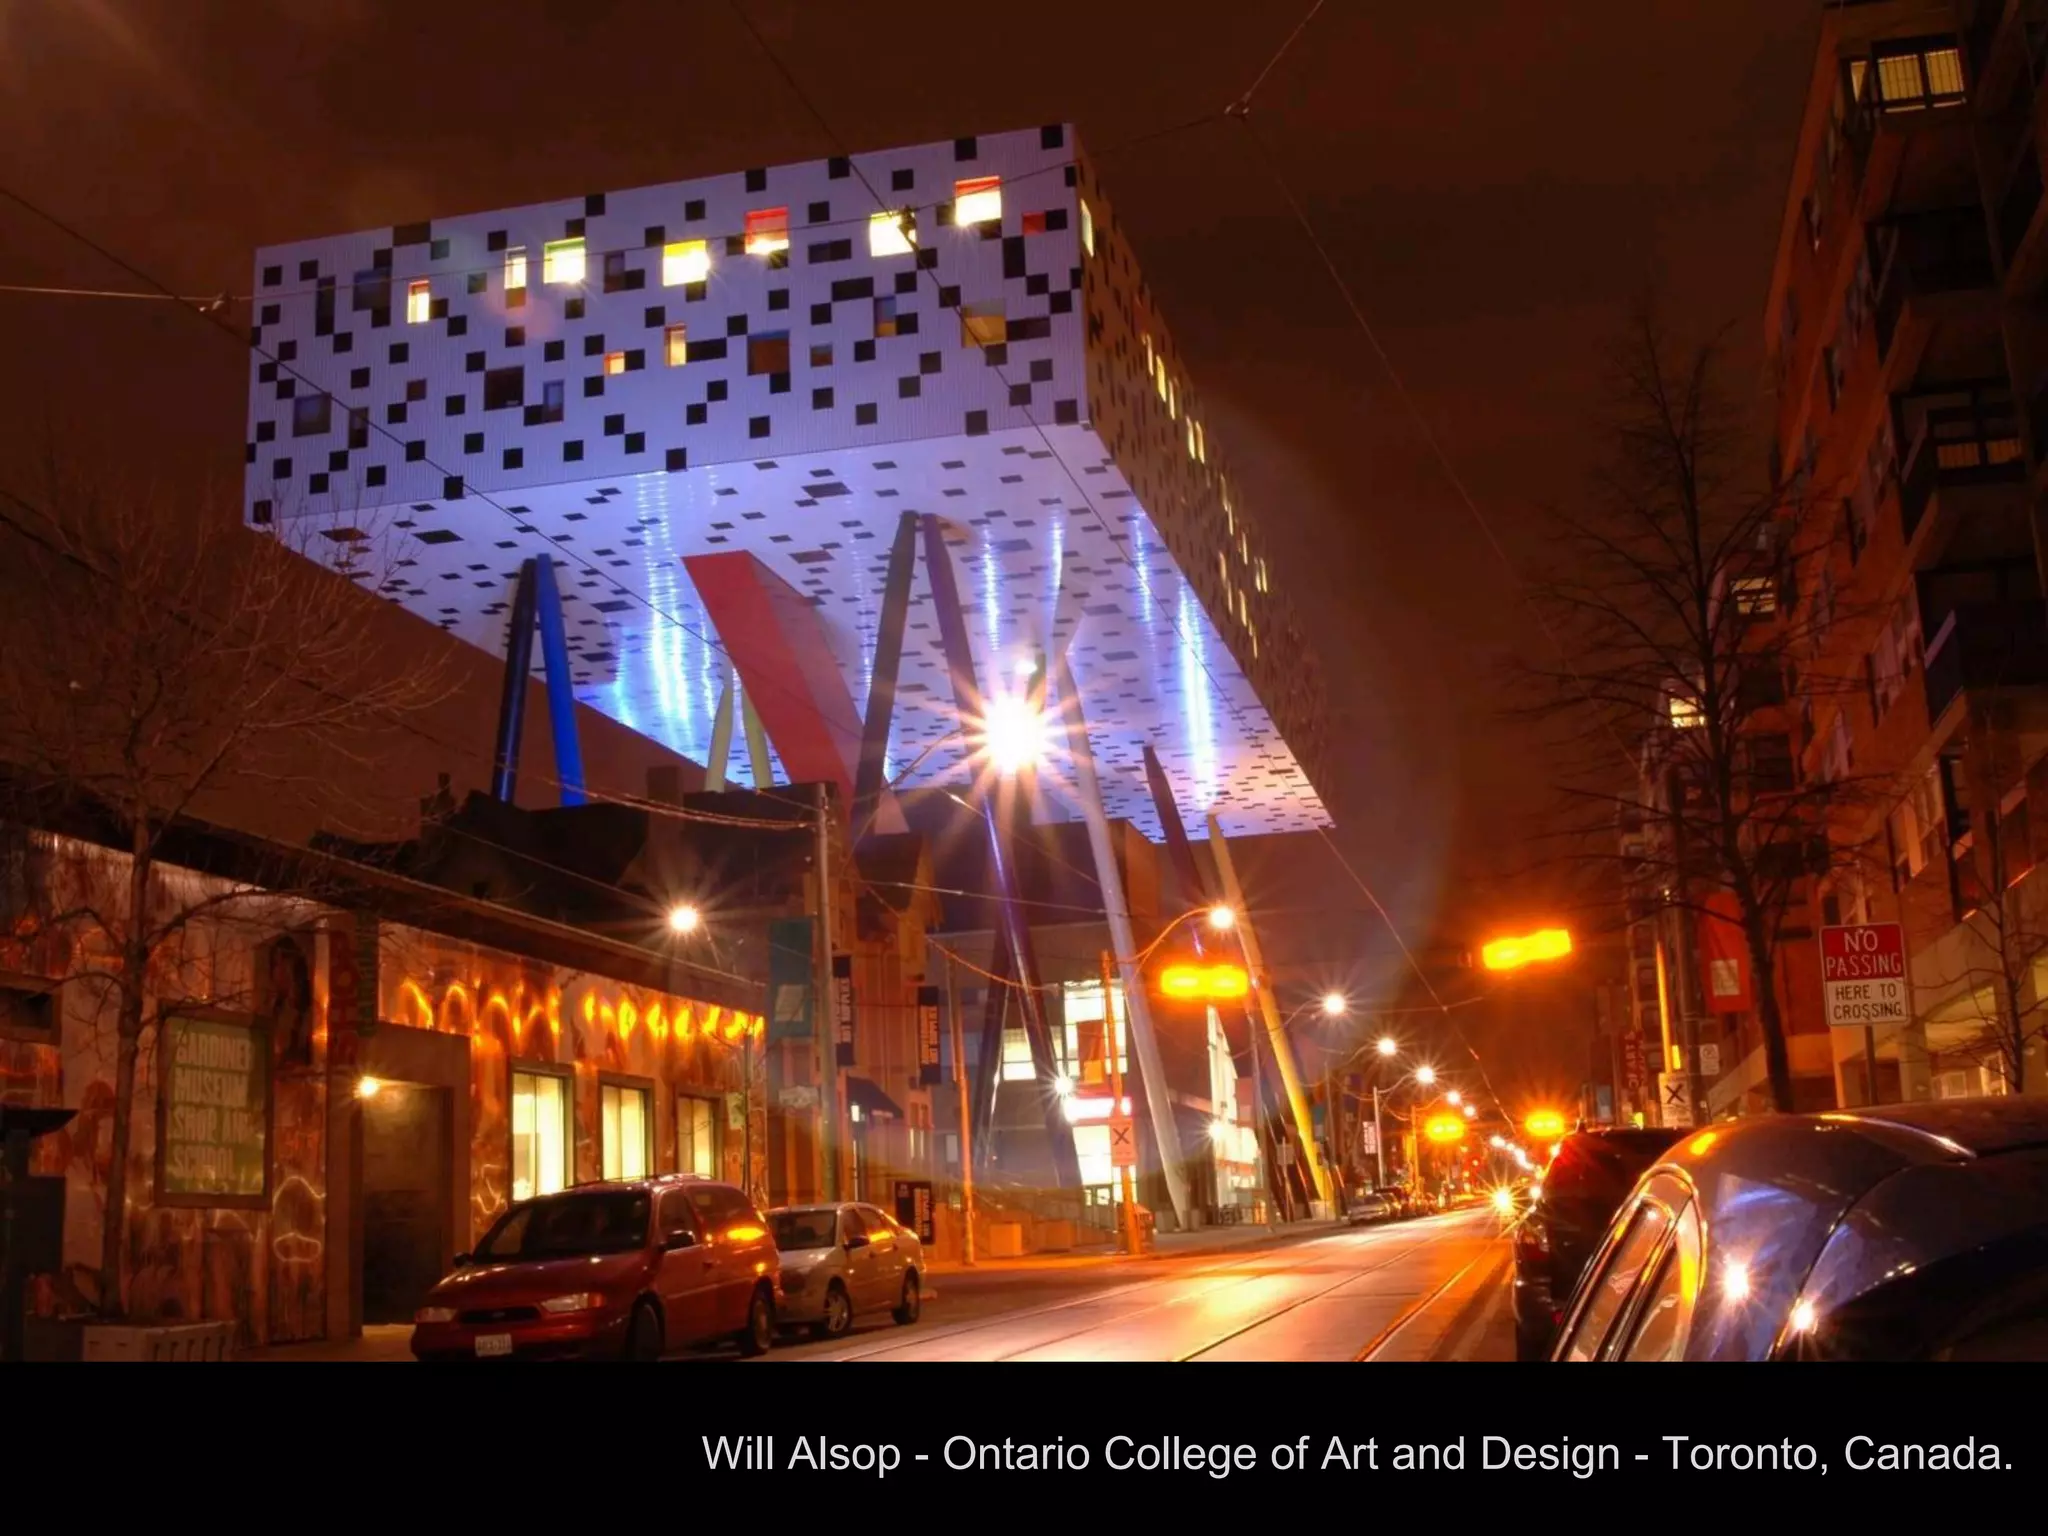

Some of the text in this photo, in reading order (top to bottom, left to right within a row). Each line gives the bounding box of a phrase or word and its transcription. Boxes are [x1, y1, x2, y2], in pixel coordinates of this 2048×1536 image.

[1843, 929, 1878, 953] NO
[1826, 952, 1902, 977] PASSING
[1835, 983, 1897, 1001] HERE TO
[1833, 1001, 1902, 1020] CROSSING
[174, 1067, 249, 1107] MUSEUM
